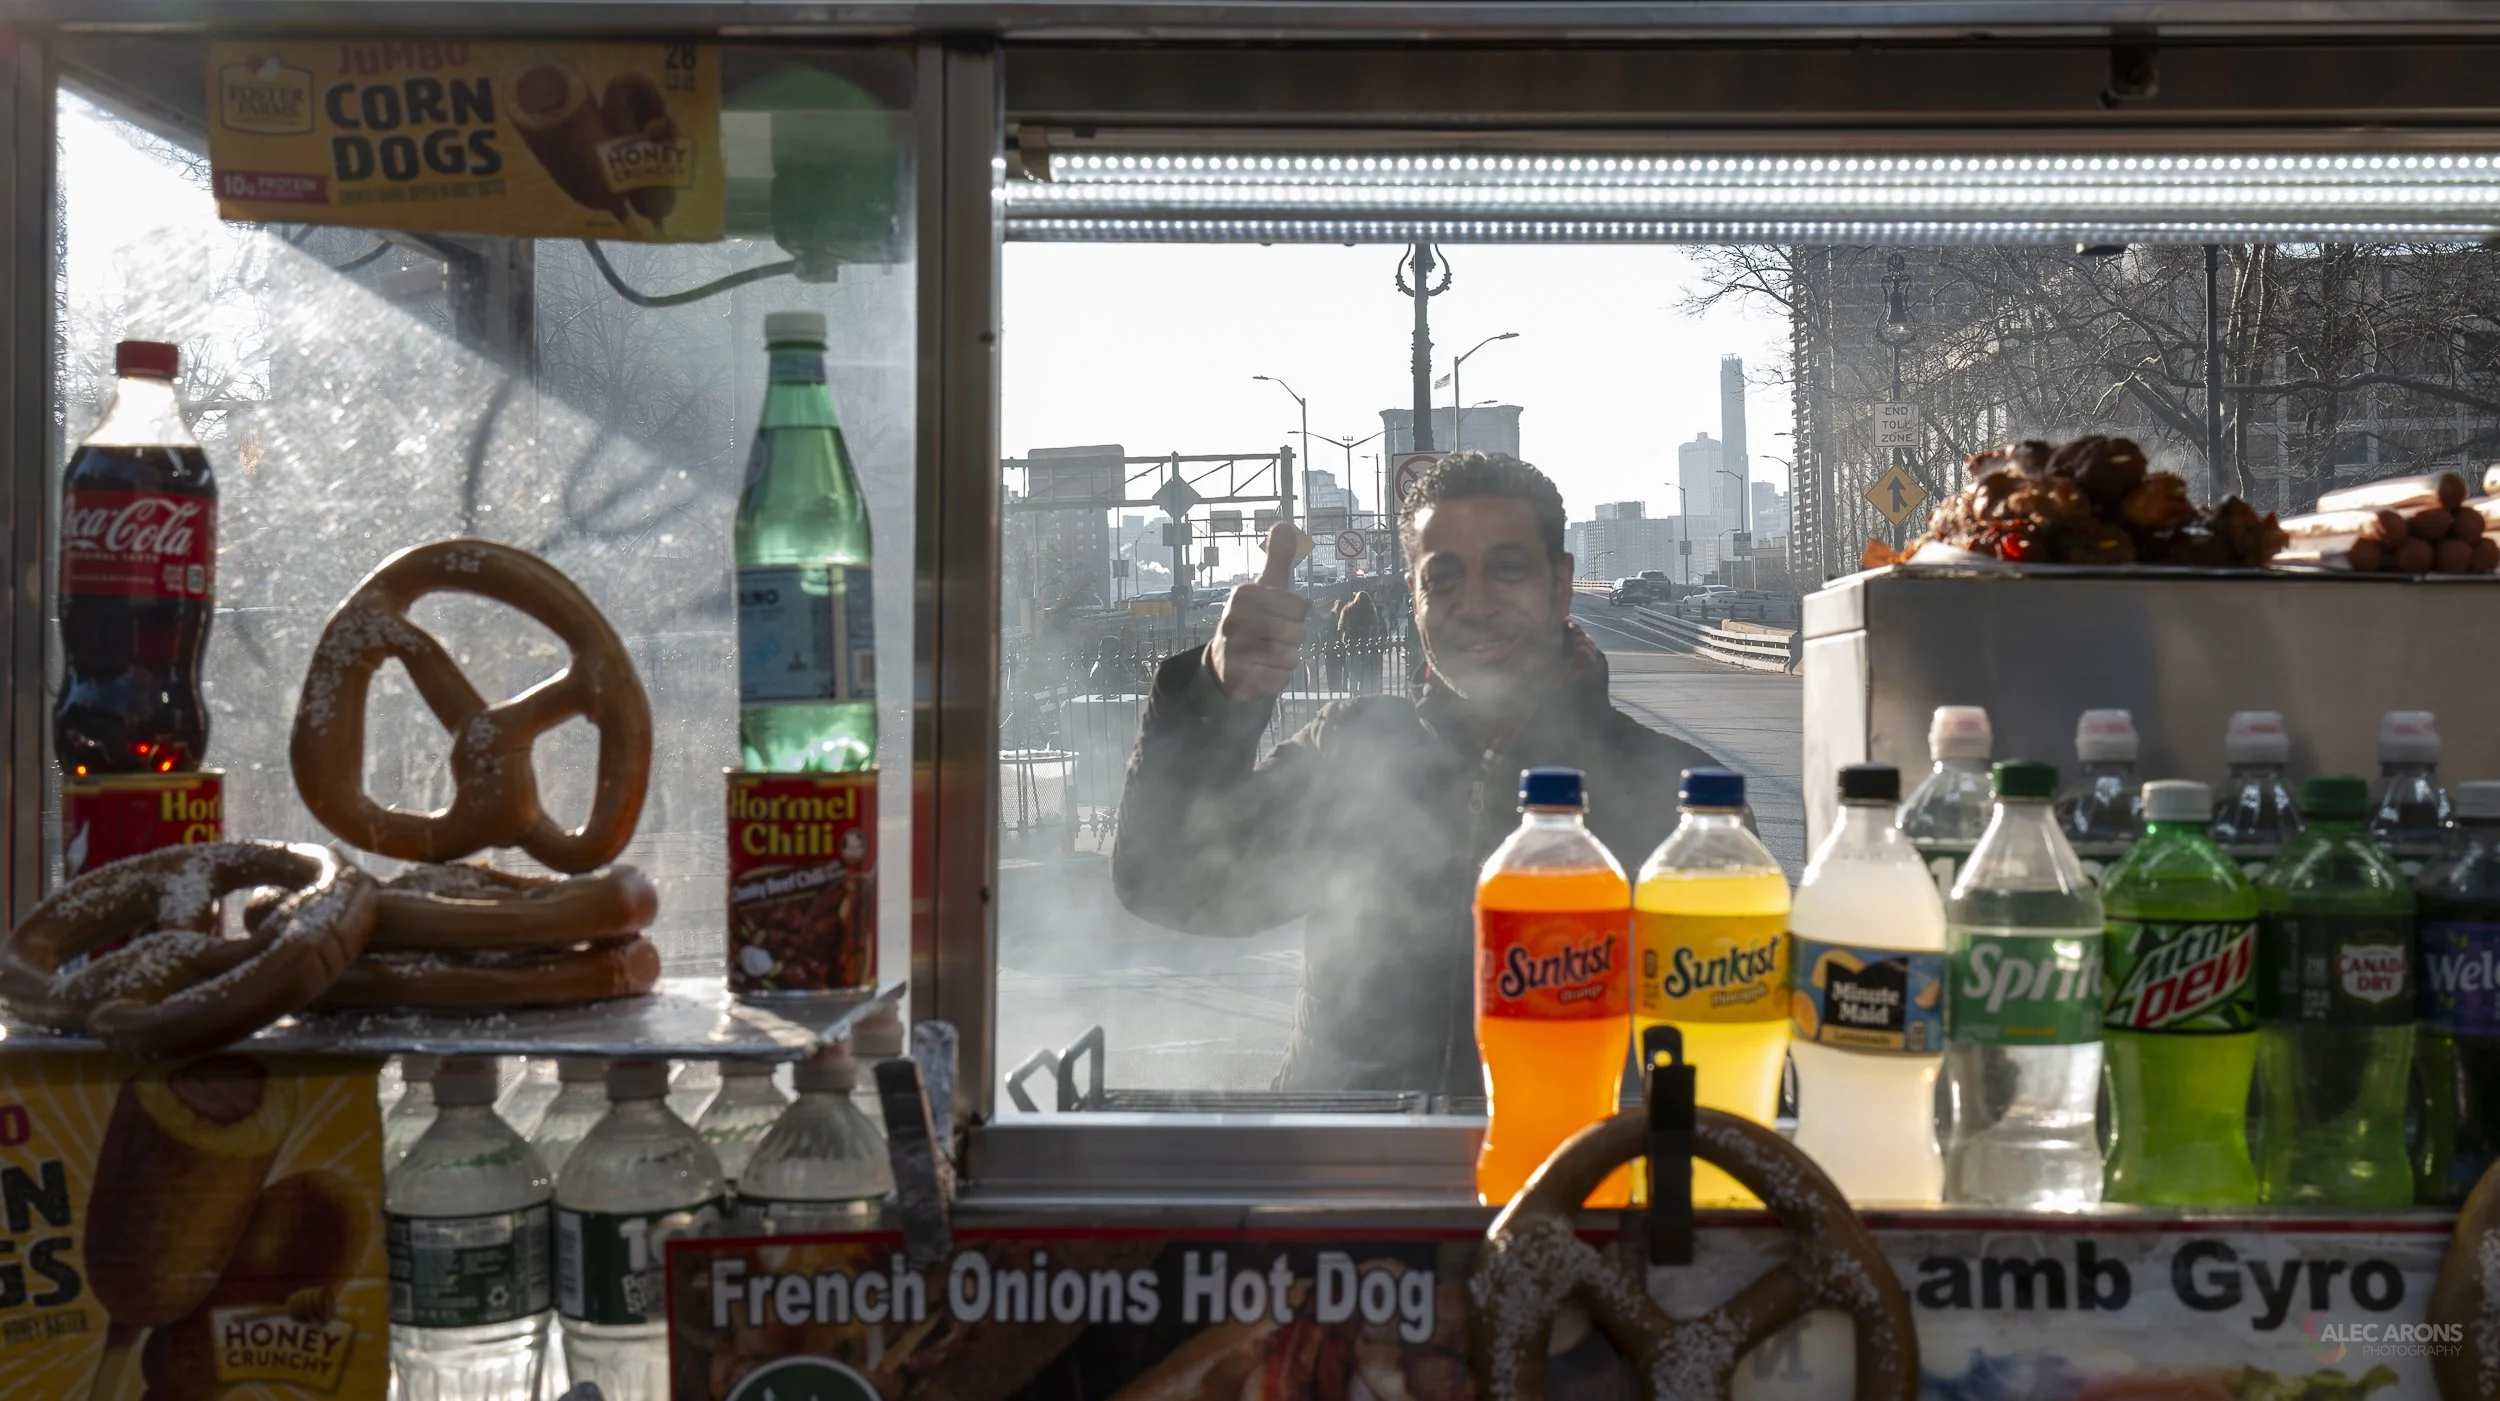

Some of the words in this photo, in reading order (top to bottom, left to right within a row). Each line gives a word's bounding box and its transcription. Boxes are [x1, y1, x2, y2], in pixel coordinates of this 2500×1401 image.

[338, 42, 471, 75] JUMBO
[325, 77, 495, 131] CORN
[332, 129, 502, 182] DOGS
[608, 146, 688, 168] HONEY
[1882, 420, 1912, 429] TOLL
[1885, 406, 1909, 416] END
[1881, 433, 1913, 442] ZONE
[729, 788, 857, 821] Hormel
[741, 822, 834, 856] Chili
[1500, 935, 1615, 998] Sunkist
[1664, 936, 1781, 998] Sunkist
[2357, 975, 2392, 991] DRY
[1831, 981, 1899, 1005] Minute
[1838, 1002, 1890, 1025] Maid
[711, 1252, 926, 1327] French
[949, 1250, 1160, 1324] Onions
[1183, 1251, 1294, 1324] Hot
[1316, 1251, 1435, 1343] Dog
[1905, 1241, 2131, 1311] amb
[2171, 1240, 2407, 1332] Gyro
[225, 1322, 342, 1357] HONEY
[227, 1351, 335, 1375] CRUNCHY
